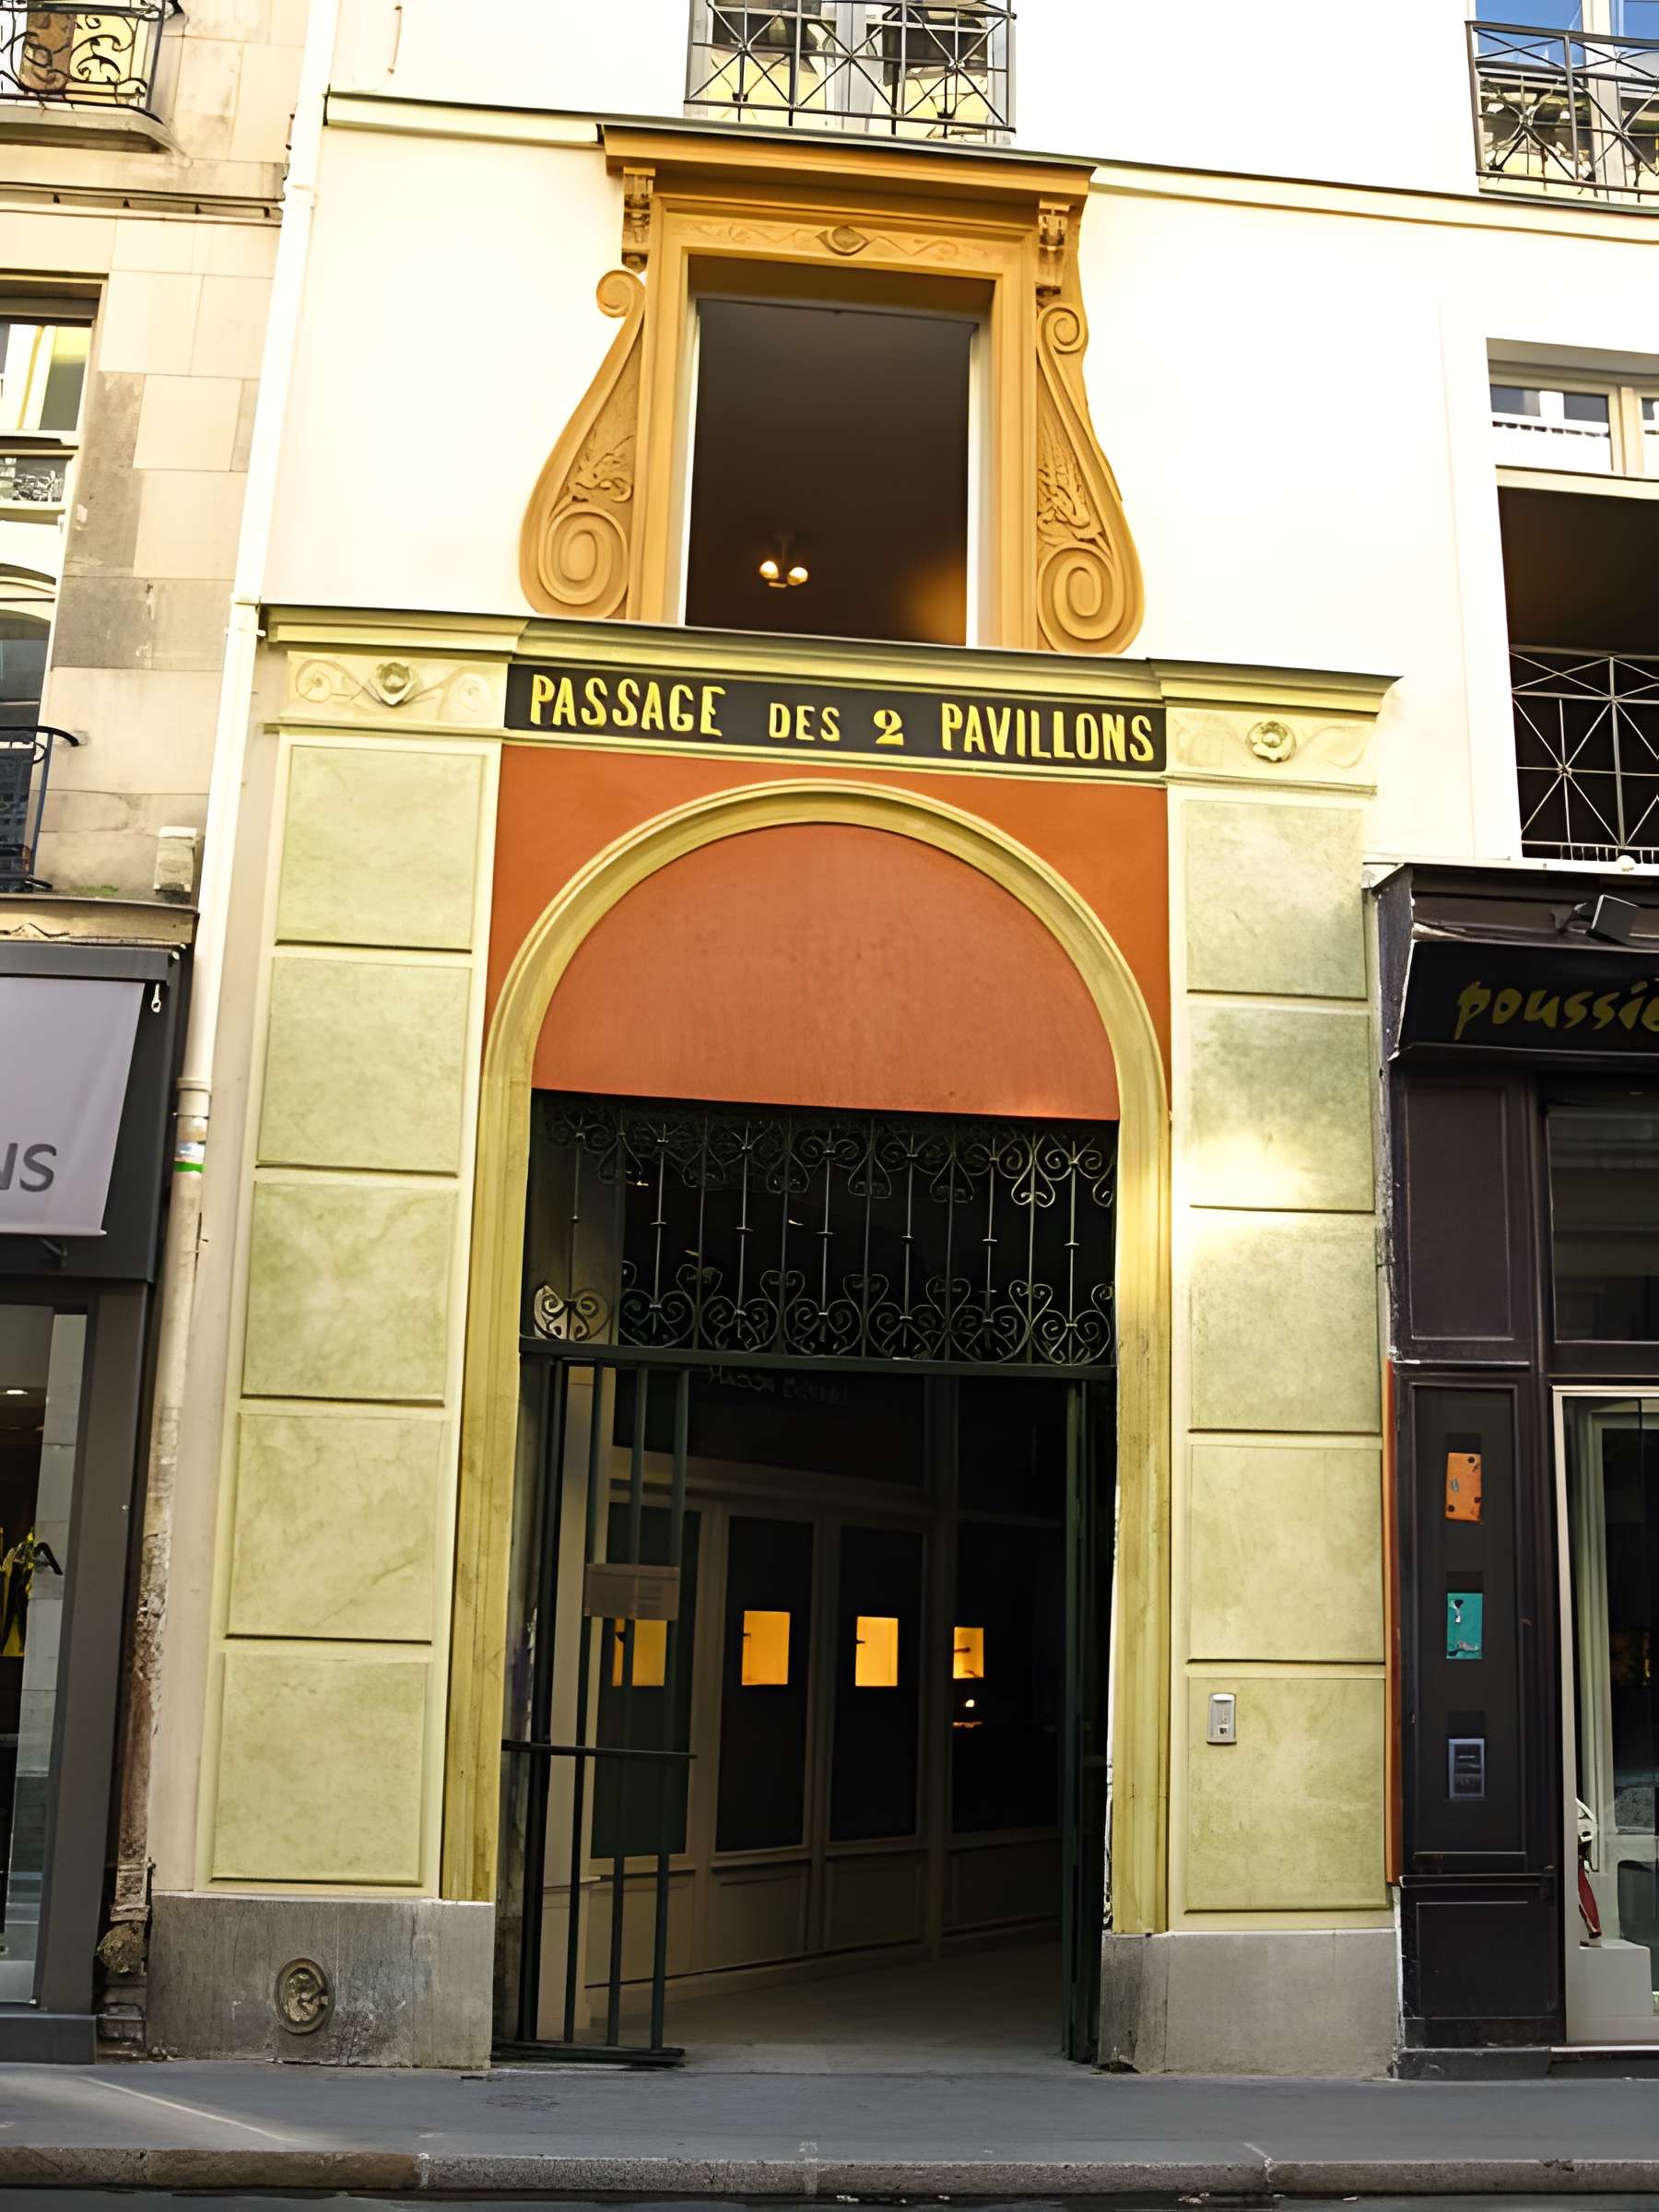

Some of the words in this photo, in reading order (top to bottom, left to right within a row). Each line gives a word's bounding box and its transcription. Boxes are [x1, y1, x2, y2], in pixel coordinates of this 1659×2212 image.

[530, 674, 726, 736] PASSAGE
[768, 702, 841, 742] DES
[873, 709, 904, 746] 2
[941, 702, 1155, 763] PAVILLONS
